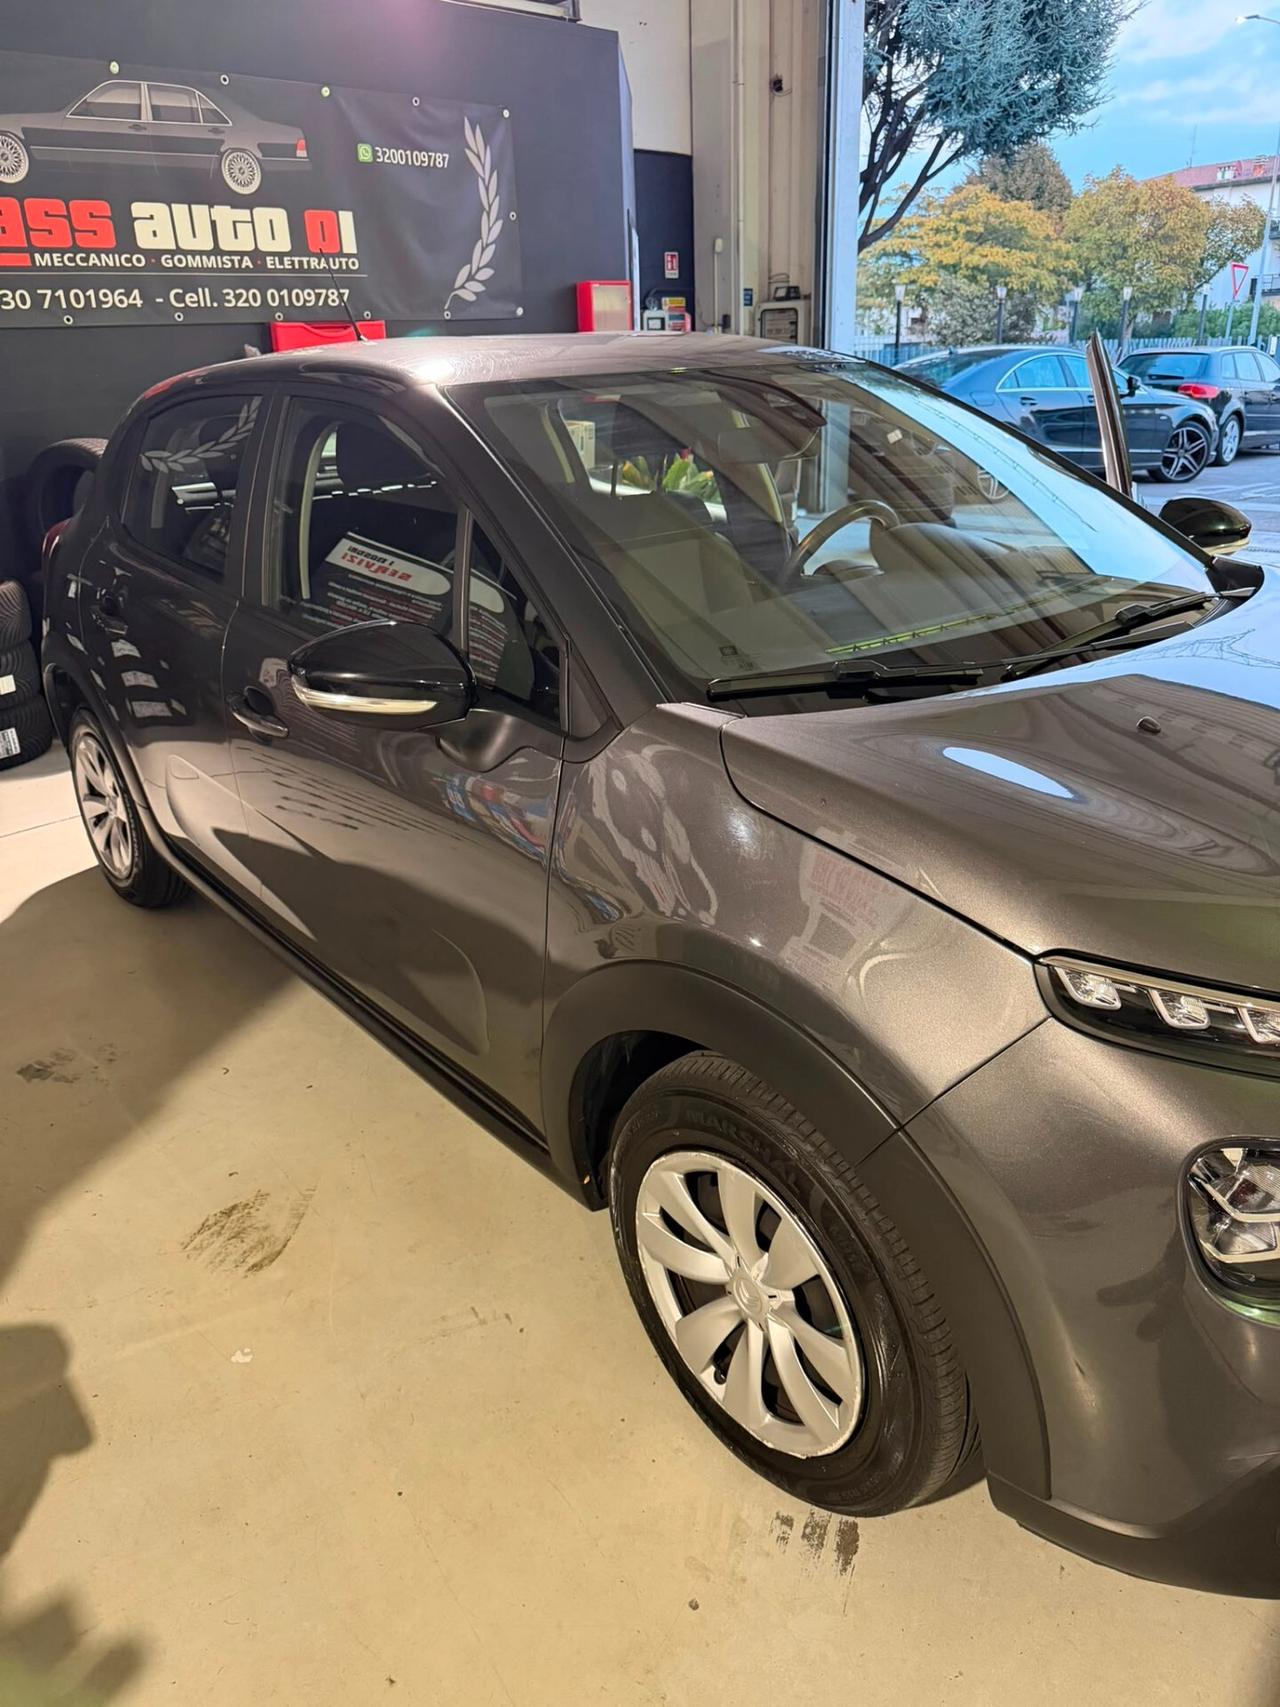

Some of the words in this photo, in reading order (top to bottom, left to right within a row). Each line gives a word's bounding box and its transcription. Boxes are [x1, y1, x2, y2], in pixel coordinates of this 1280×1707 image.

[375, 147, 449, 168] 3200109787
[34, 253, 146, 267] MECCANICO
[161, 254, 254, 269] GOMMISTA
[266, 256, 360, 270] ELETTRAUTO
[37, 289, 143, 310] 7101964
[169, 287, 218, 308] Cell.
[222, 288, 262, 308] 320
[266, 288, 350, 308] 0109787
